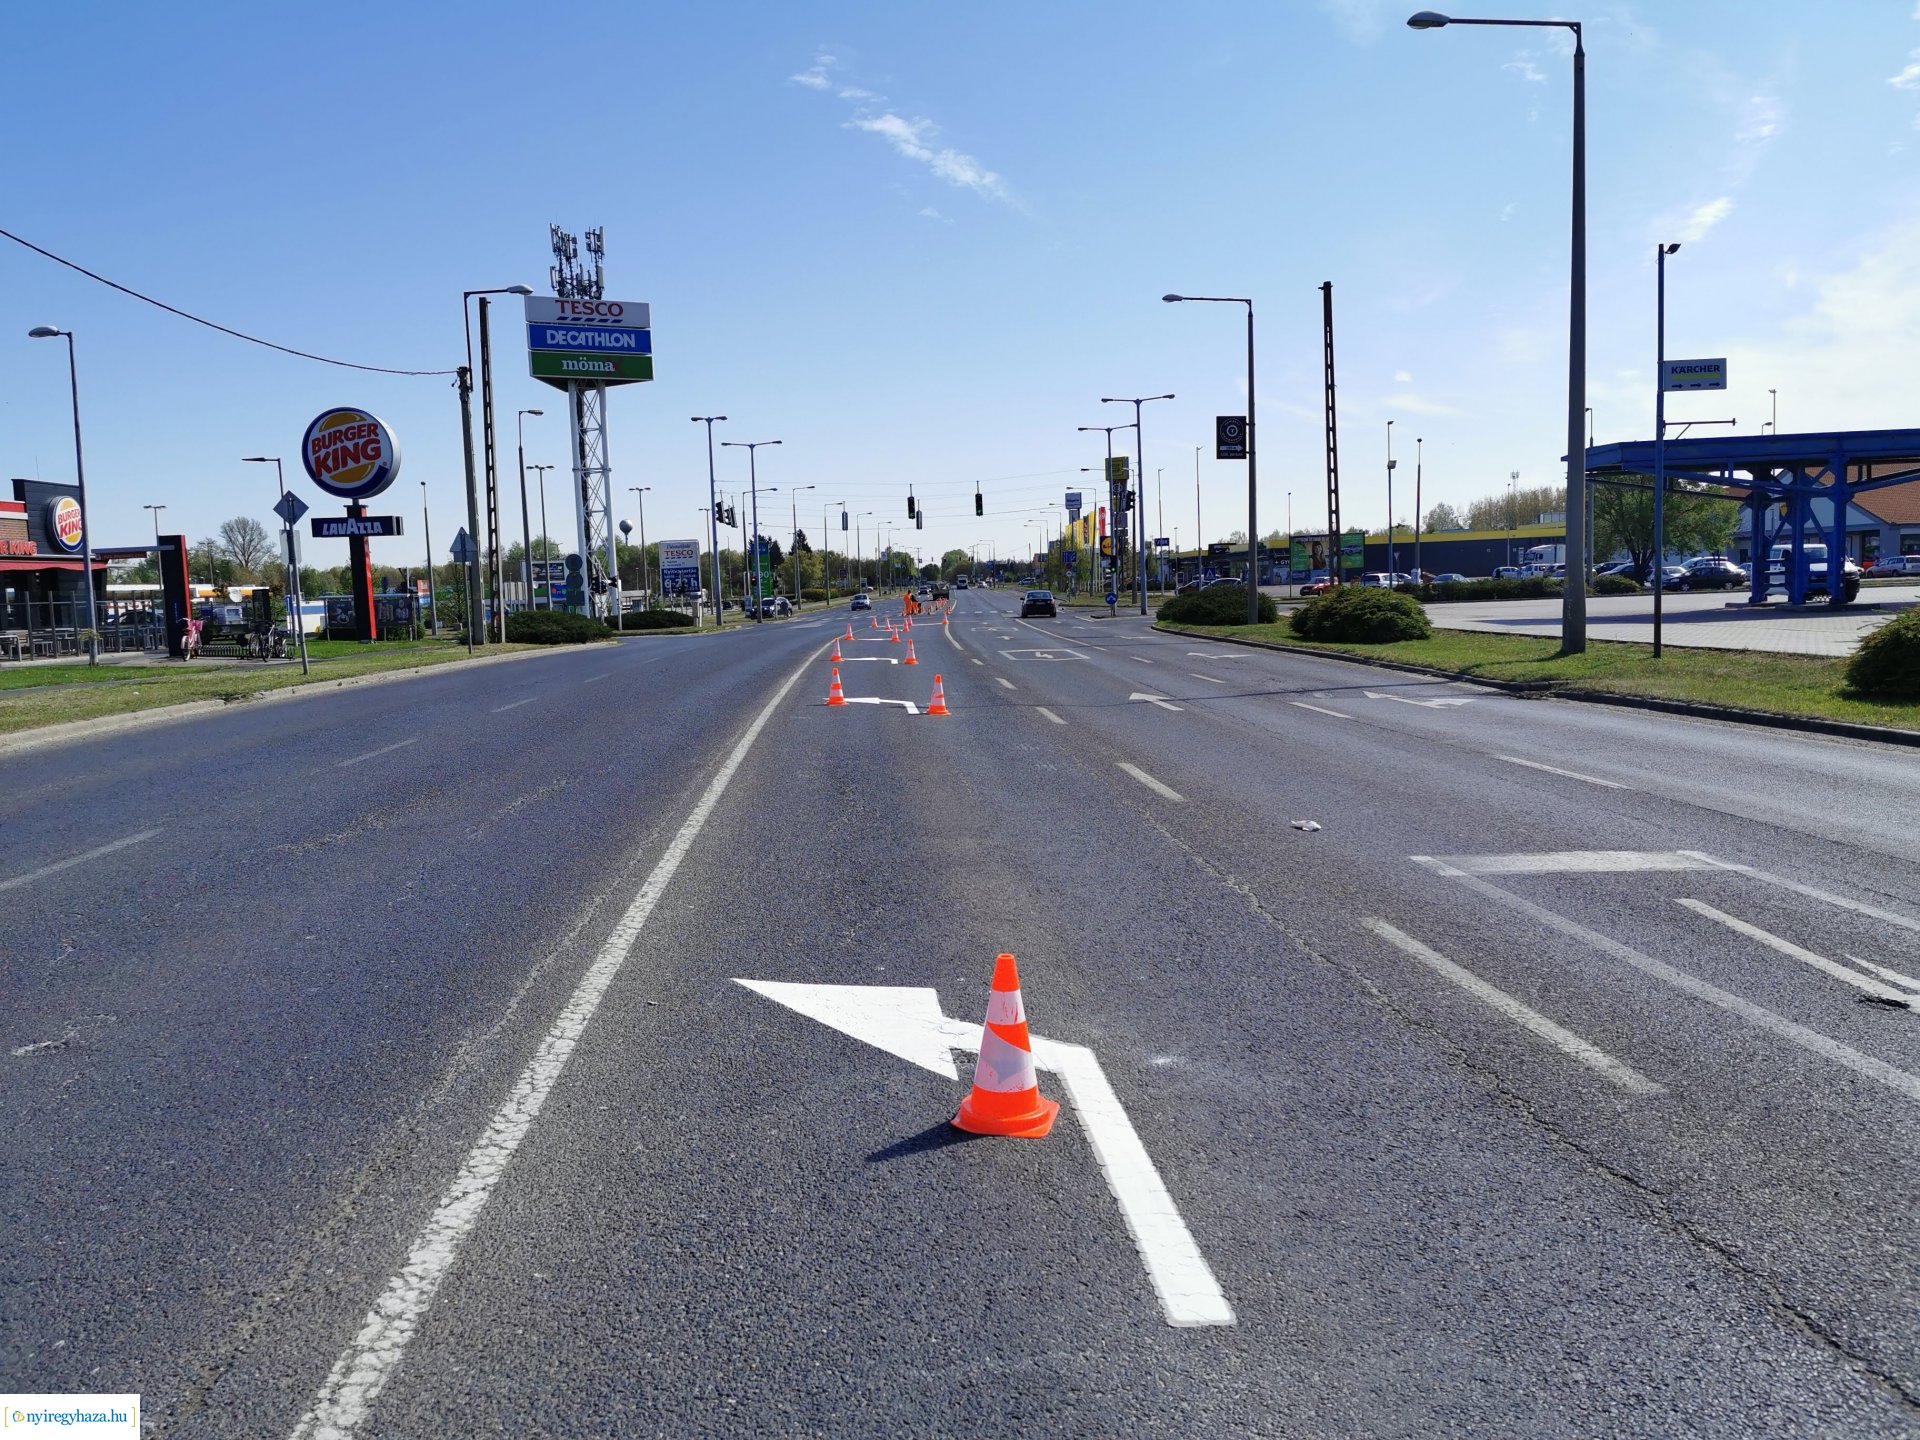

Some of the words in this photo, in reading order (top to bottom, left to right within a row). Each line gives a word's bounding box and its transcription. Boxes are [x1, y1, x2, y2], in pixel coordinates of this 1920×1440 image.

[555, 299, 624, 317] TESCO
[546, 329, 636, 348] DECATHLON
[1671, 364, 1720, 374] KÄRCHER
[312, 423, 379, 456] BURGER
[314, 437, 382, 479] KING
[322, 517, 384, 536] LAVAZZA
[9, 540, 37, 556] KING
[663, 549, 694, 557] TESCO
